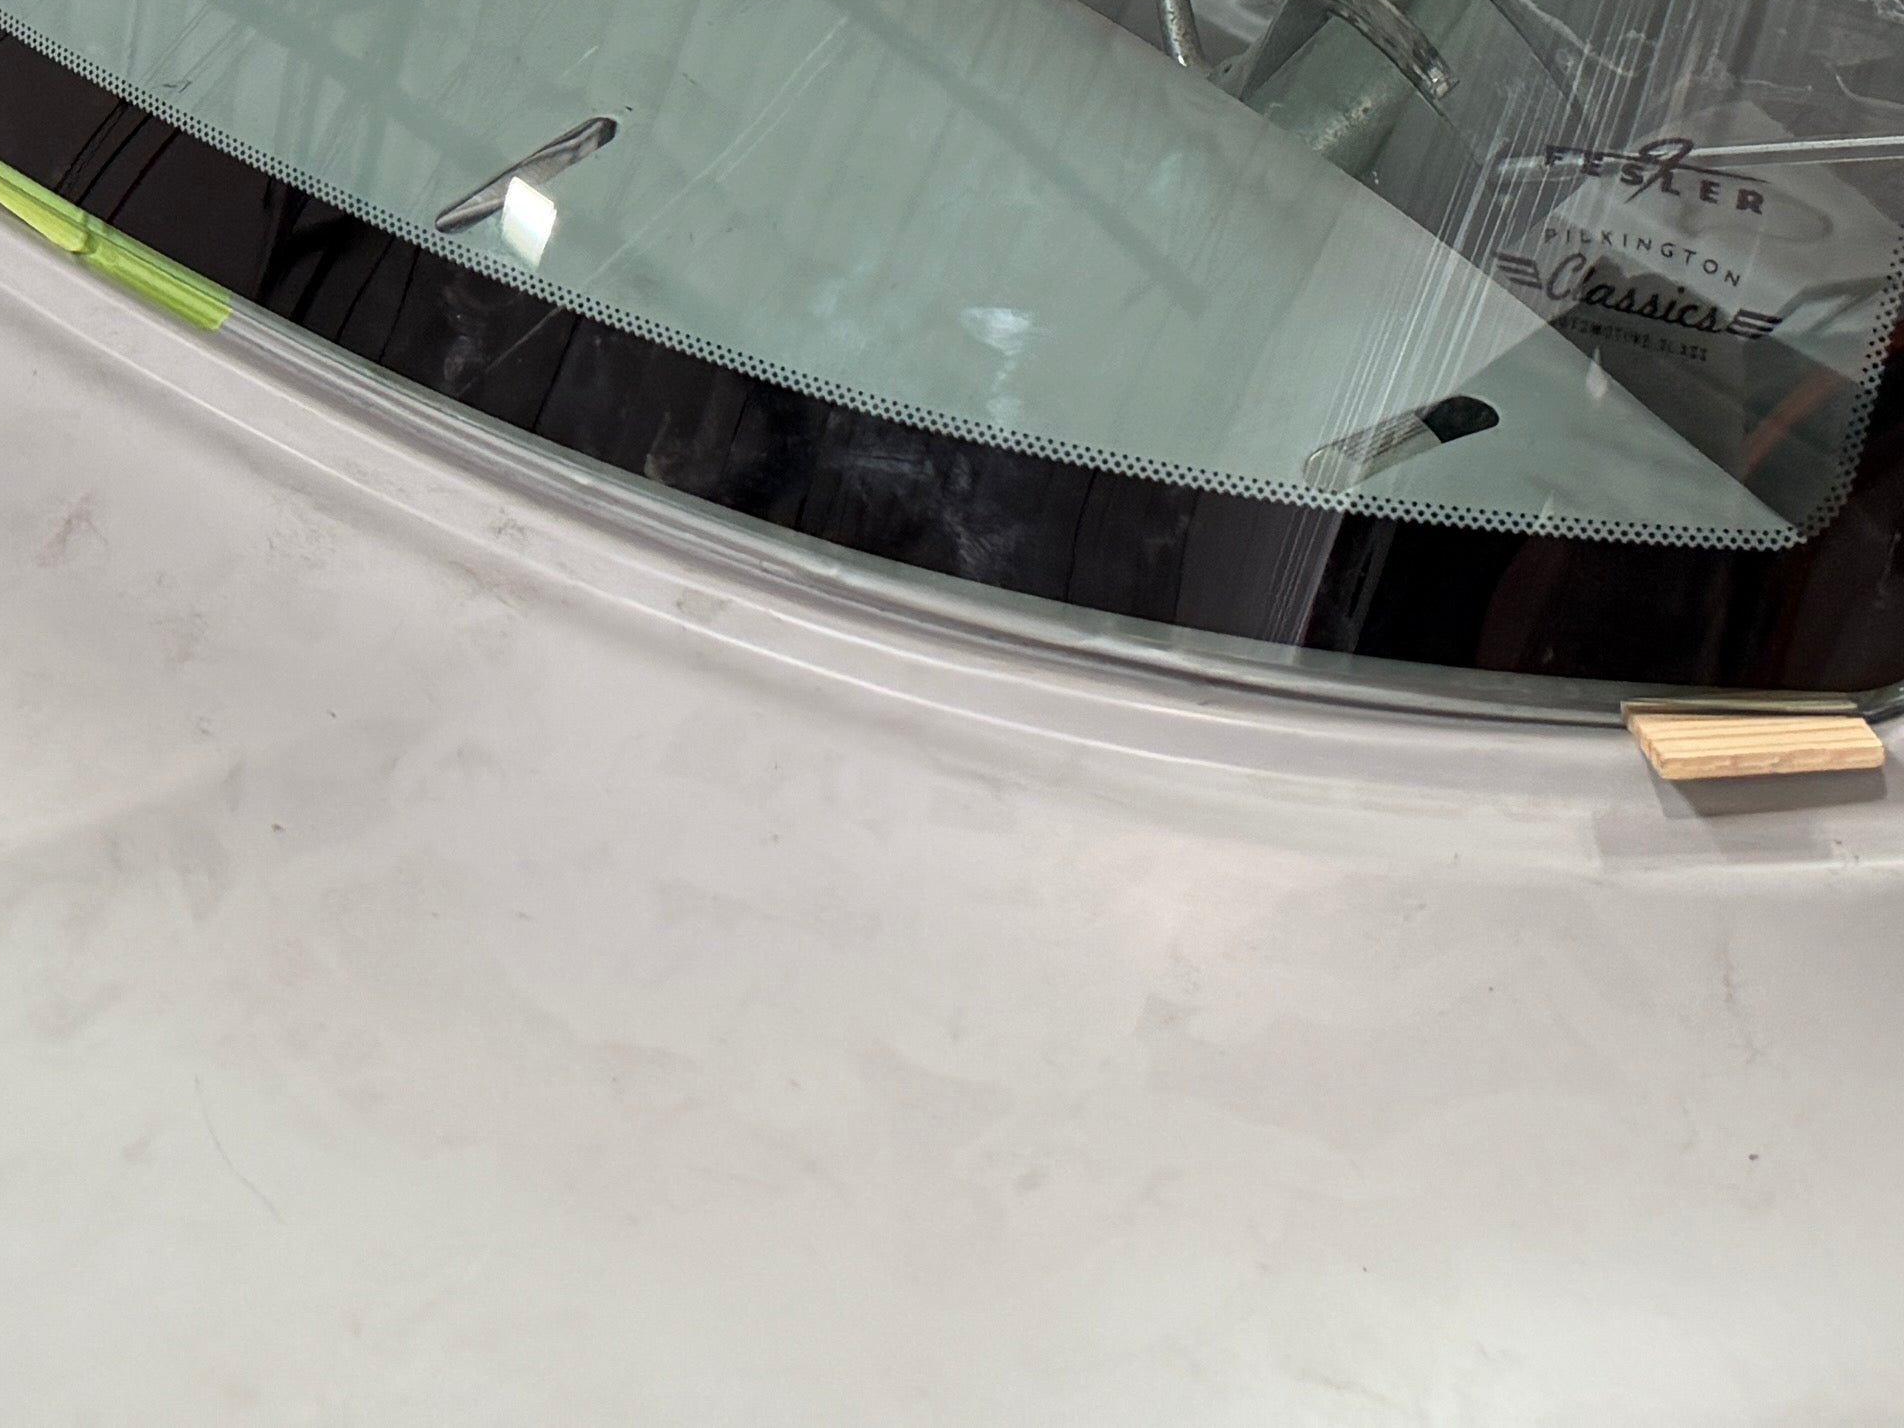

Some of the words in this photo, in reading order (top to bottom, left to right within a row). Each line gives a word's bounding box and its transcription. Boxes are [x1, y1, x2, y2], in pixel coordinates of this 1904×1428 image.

[1544, 142, 1765, 216] FESLER
[1545, 227, 1742, 287] PILKINGTON
[1546, 252, 1724, 334] Classics
